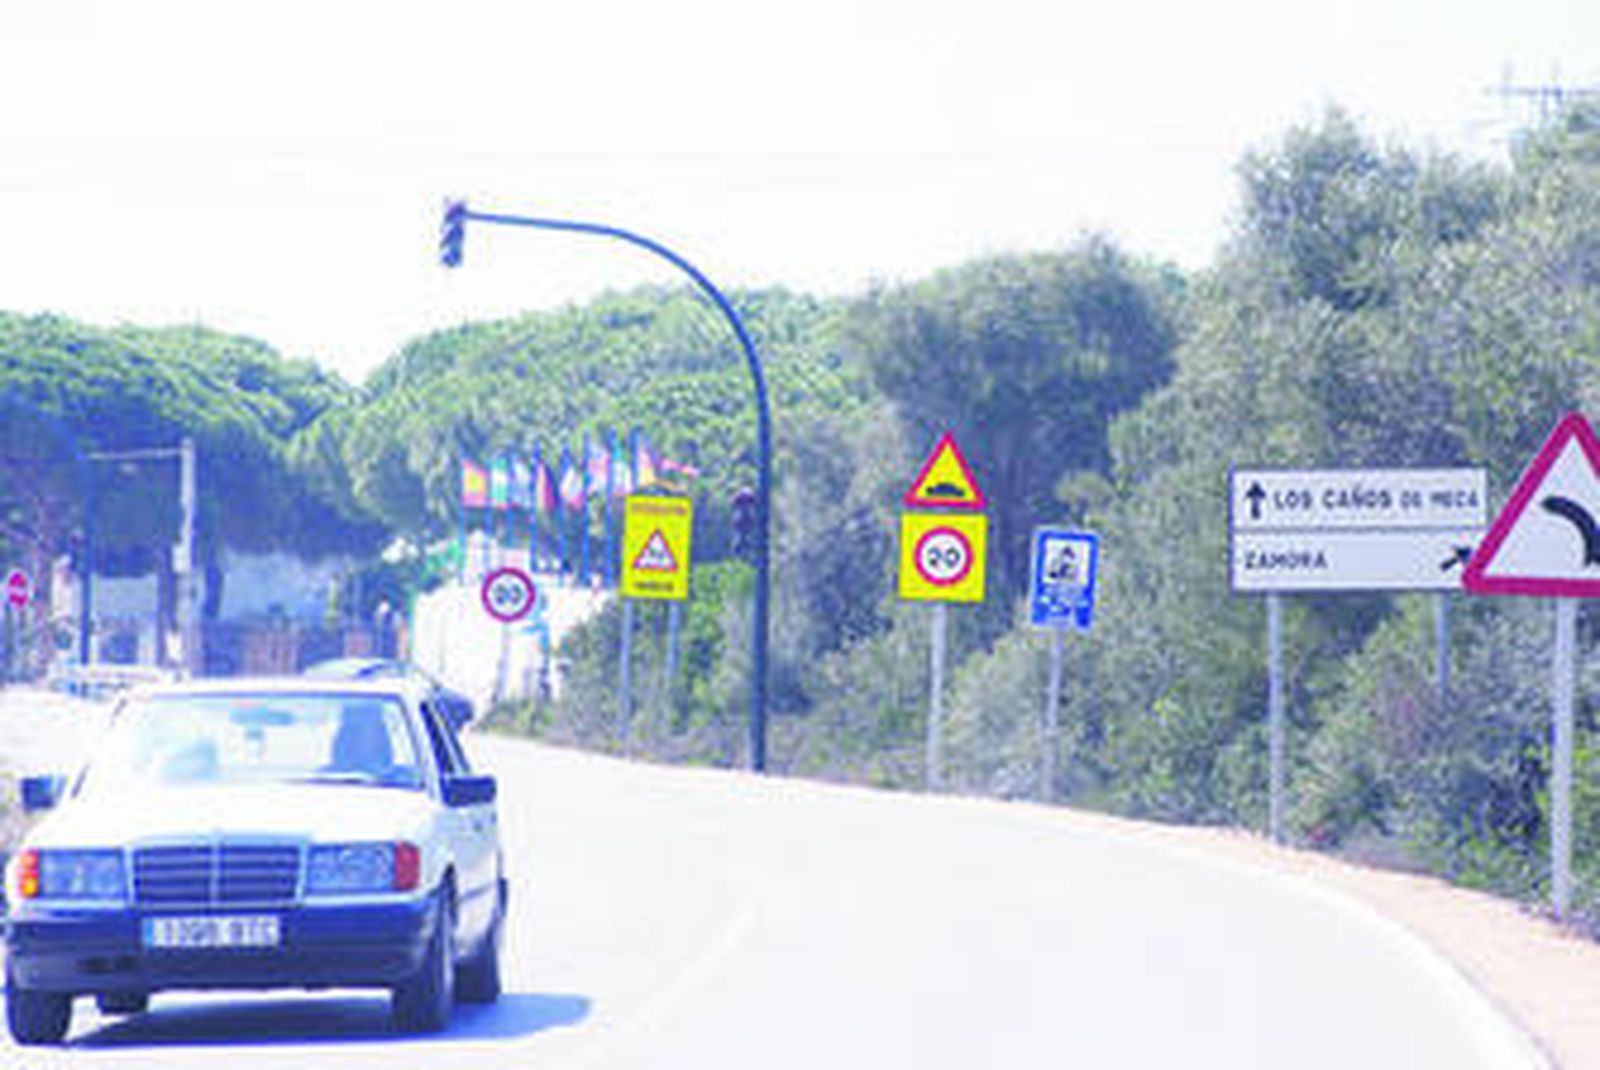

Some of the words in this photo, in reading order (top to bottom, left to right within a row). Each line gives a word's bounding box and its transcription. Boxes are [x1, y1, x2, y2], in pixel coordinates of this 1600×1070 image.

[1273, 489, 1312, 510] LOS
[1321, 482, 1392, 510] CAÑOS
[1400, 490, 1422, 509] DE
[927, 546, 961, 569] 20
[1245, 550, 1328, 570] ZAMORA
